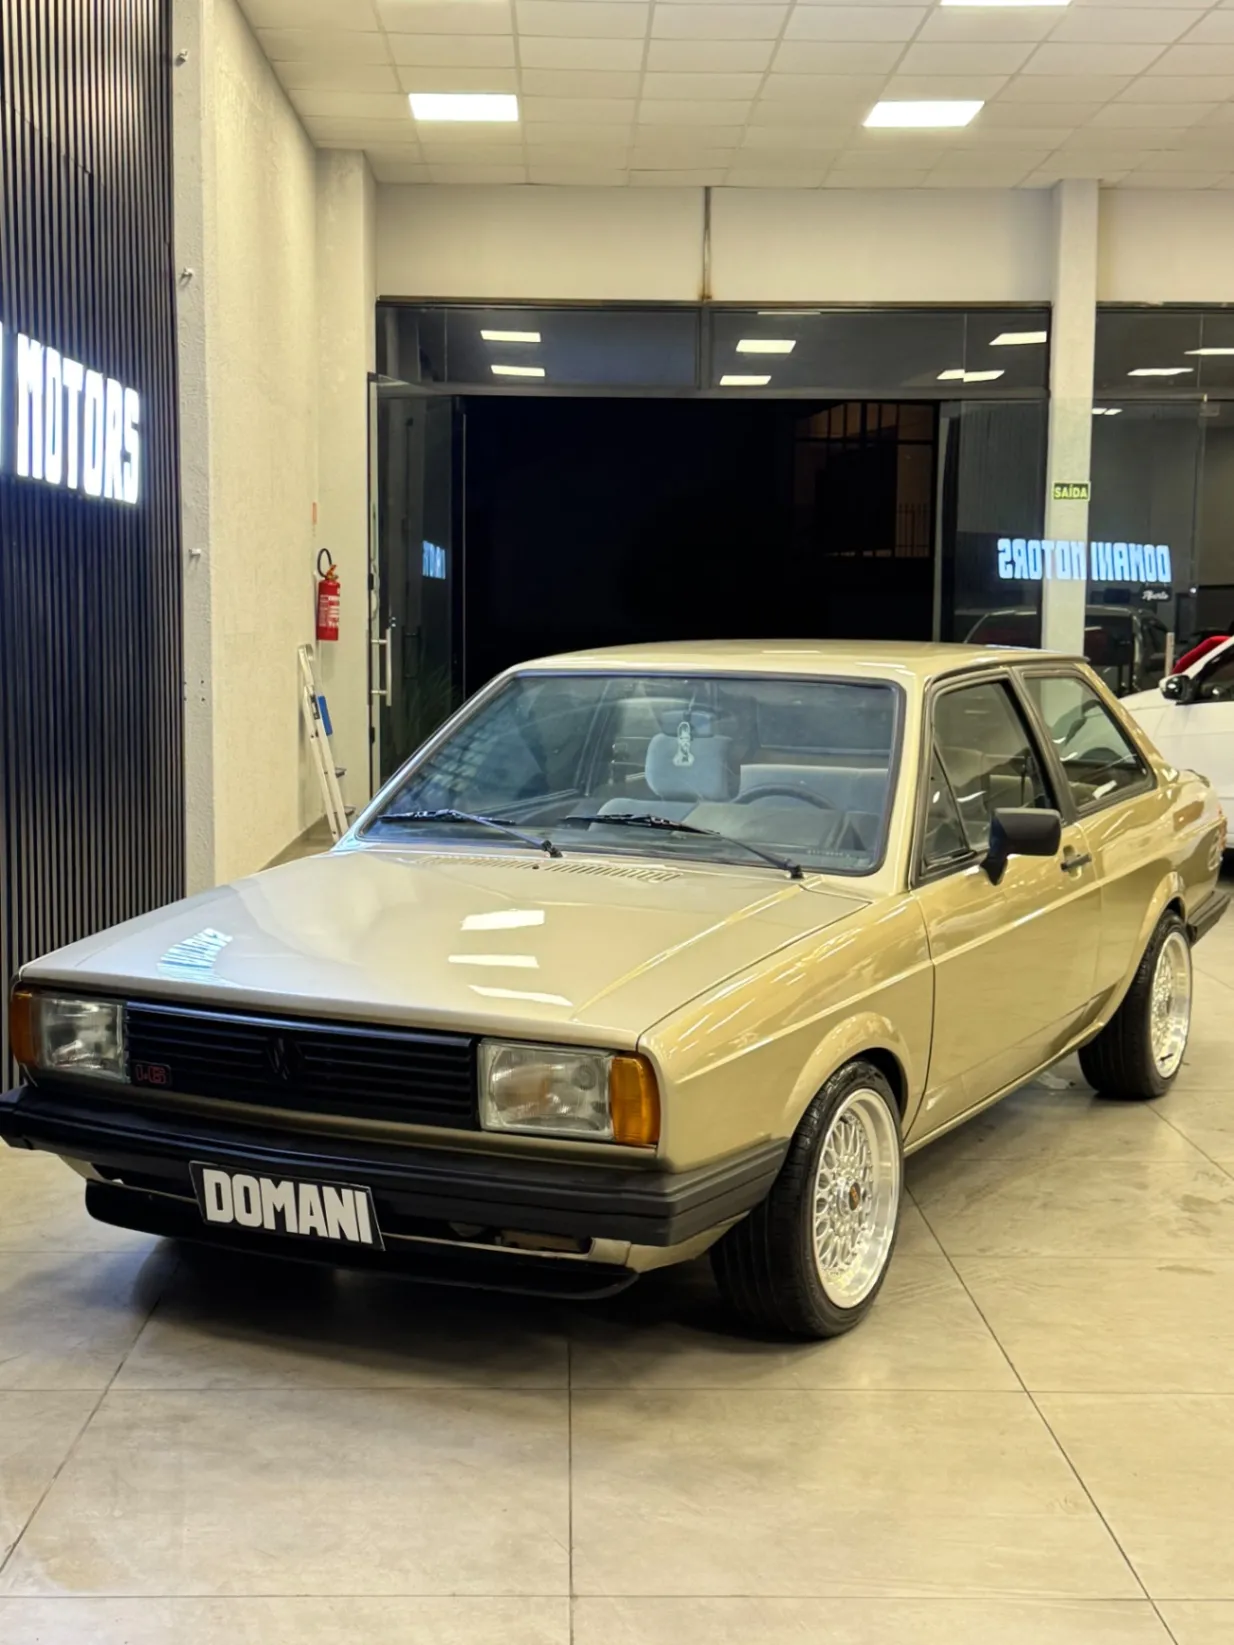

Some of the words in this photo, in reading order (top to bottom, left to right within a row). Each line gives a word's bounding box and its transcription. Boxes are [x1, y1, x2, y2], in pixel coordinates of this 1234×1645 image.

[17, 332, 140, 504] MOTORS
[1054, 484, 1088, 498] SAÍDA
[202, 1168, 373, 1244] DOMANI
